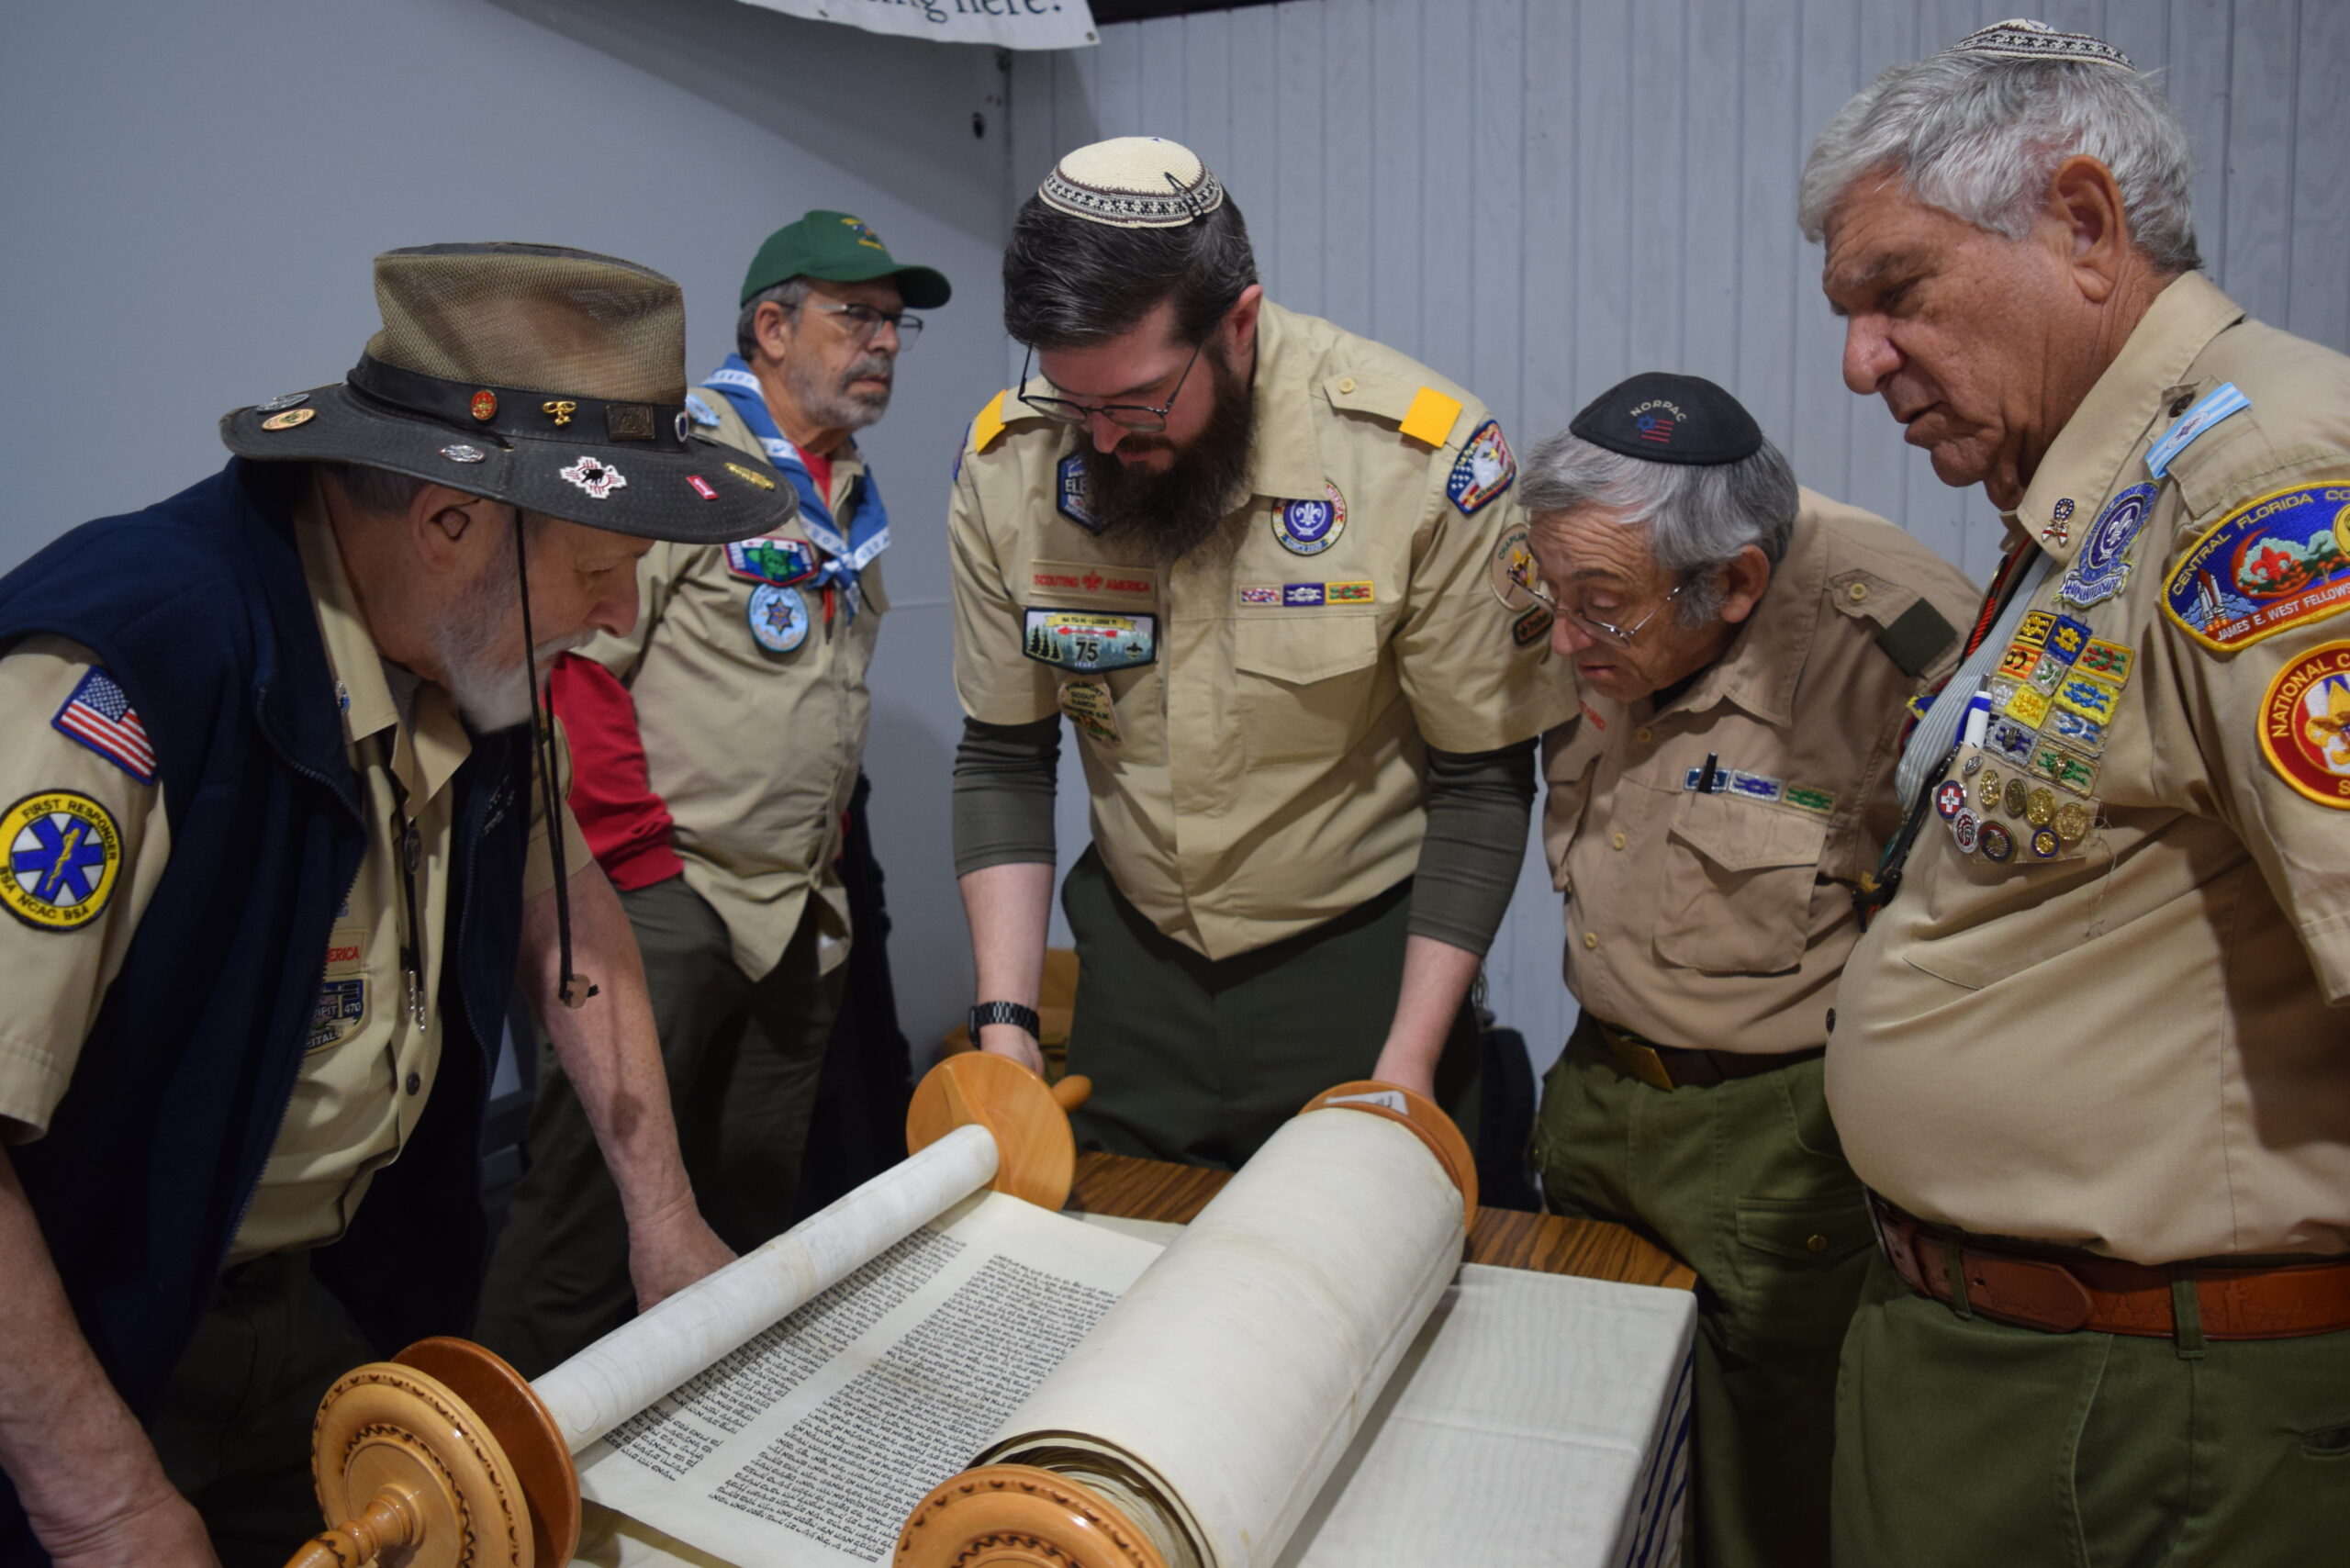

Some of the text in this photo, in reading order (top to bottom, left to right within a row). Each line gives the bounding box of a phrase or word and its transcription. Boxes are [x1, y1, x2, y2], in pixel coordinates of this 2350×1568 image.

[1629, 399, 1687, 422] NORPAC
[2172, 493, 2314, 596] CENTRAL FLORIDA
[1034, 573, 1150, 592] SCOUTING AMERICA
[2217, 585, 2350, 642] JAMES E. WEST FELLOWS
[1076, 641, 1099, 662] 75
[2271, 658, 2333, 737] NATIONAL
[22, 799, 118, 861] FIRST RESPONDER
[17, 895, 57, 919] NCAC
[63, 905, 90, 921] BSA
[325, 946, 359, 963] ERICA
[344, 1002, 362, 1014] 470
[307, 1033, 336, 1047] ITAL
